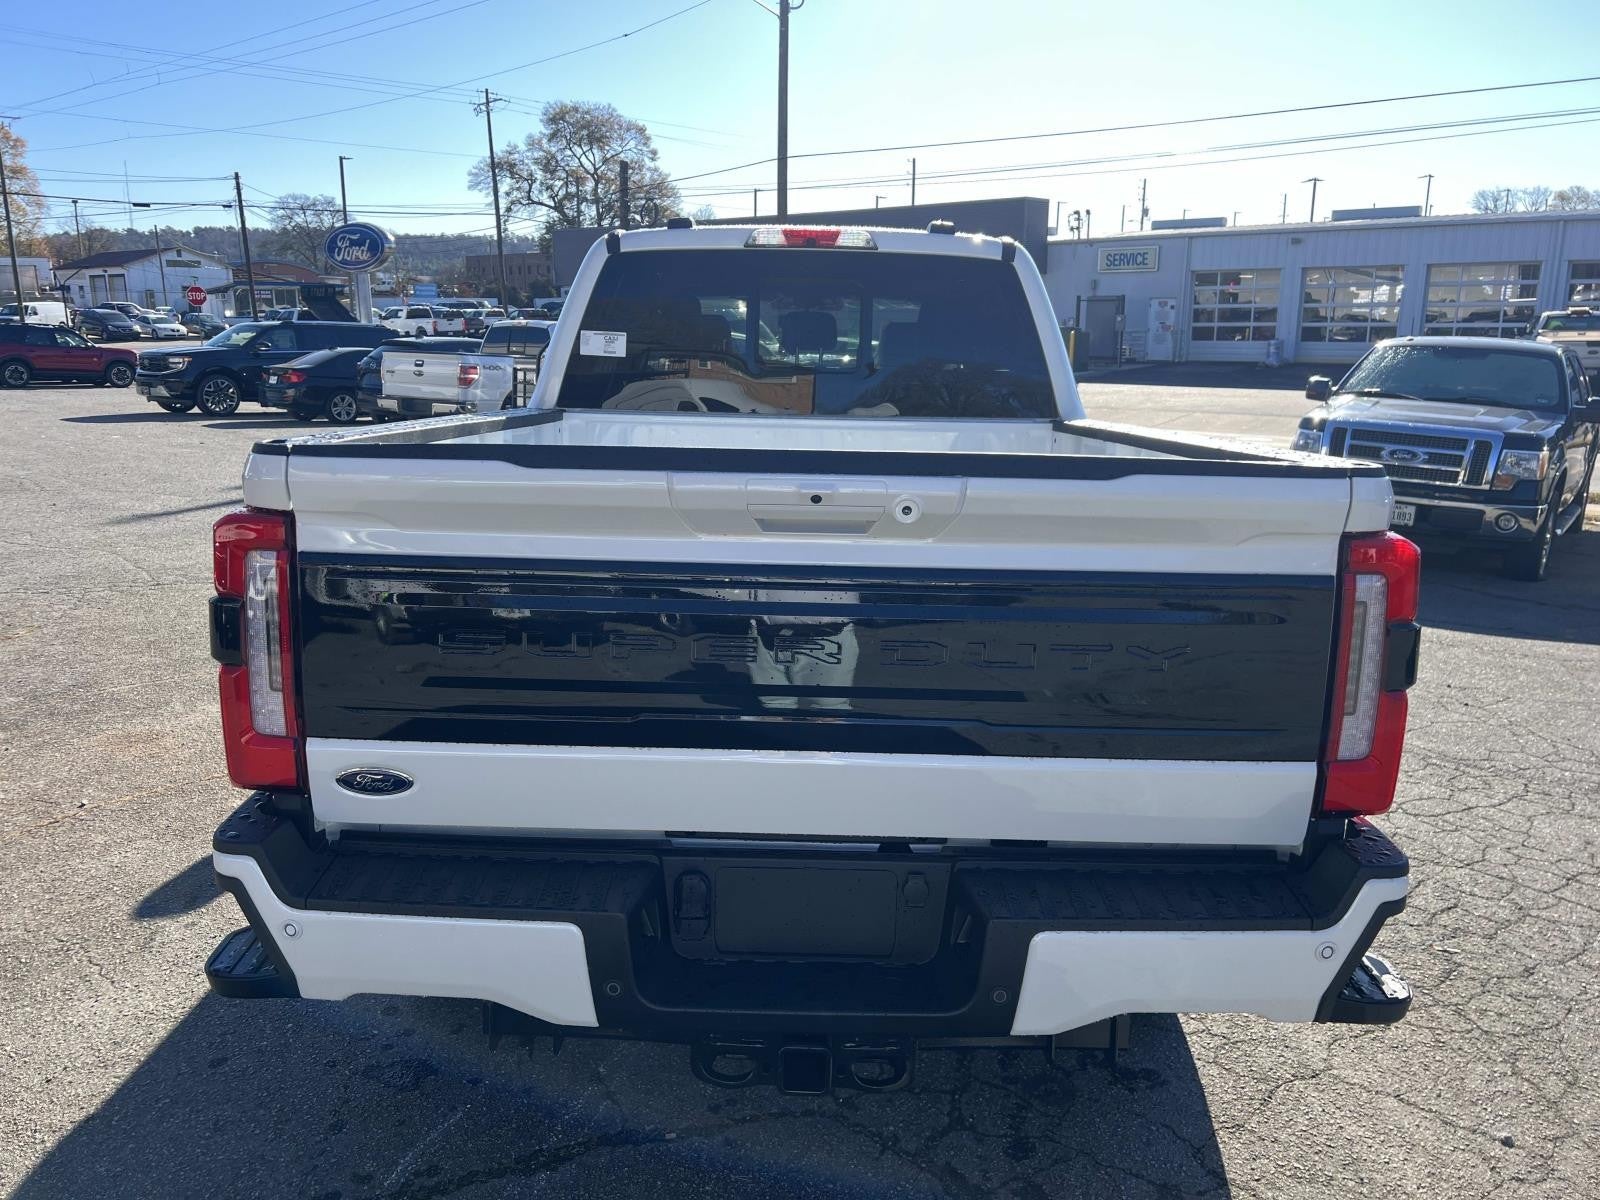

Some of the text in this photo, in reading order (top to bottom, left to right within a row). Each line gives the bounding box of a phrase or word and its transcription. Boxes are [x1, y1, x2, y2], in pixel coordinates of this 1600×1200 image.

[334, 233, 371, 261] Ford
[1105, 251, 1150, 267] SERVICE
[187, 292, 206, 300] STOP
[437, 630, 1192, 672] SUPER DUTY
[353, 773, 395, 790] Ford
